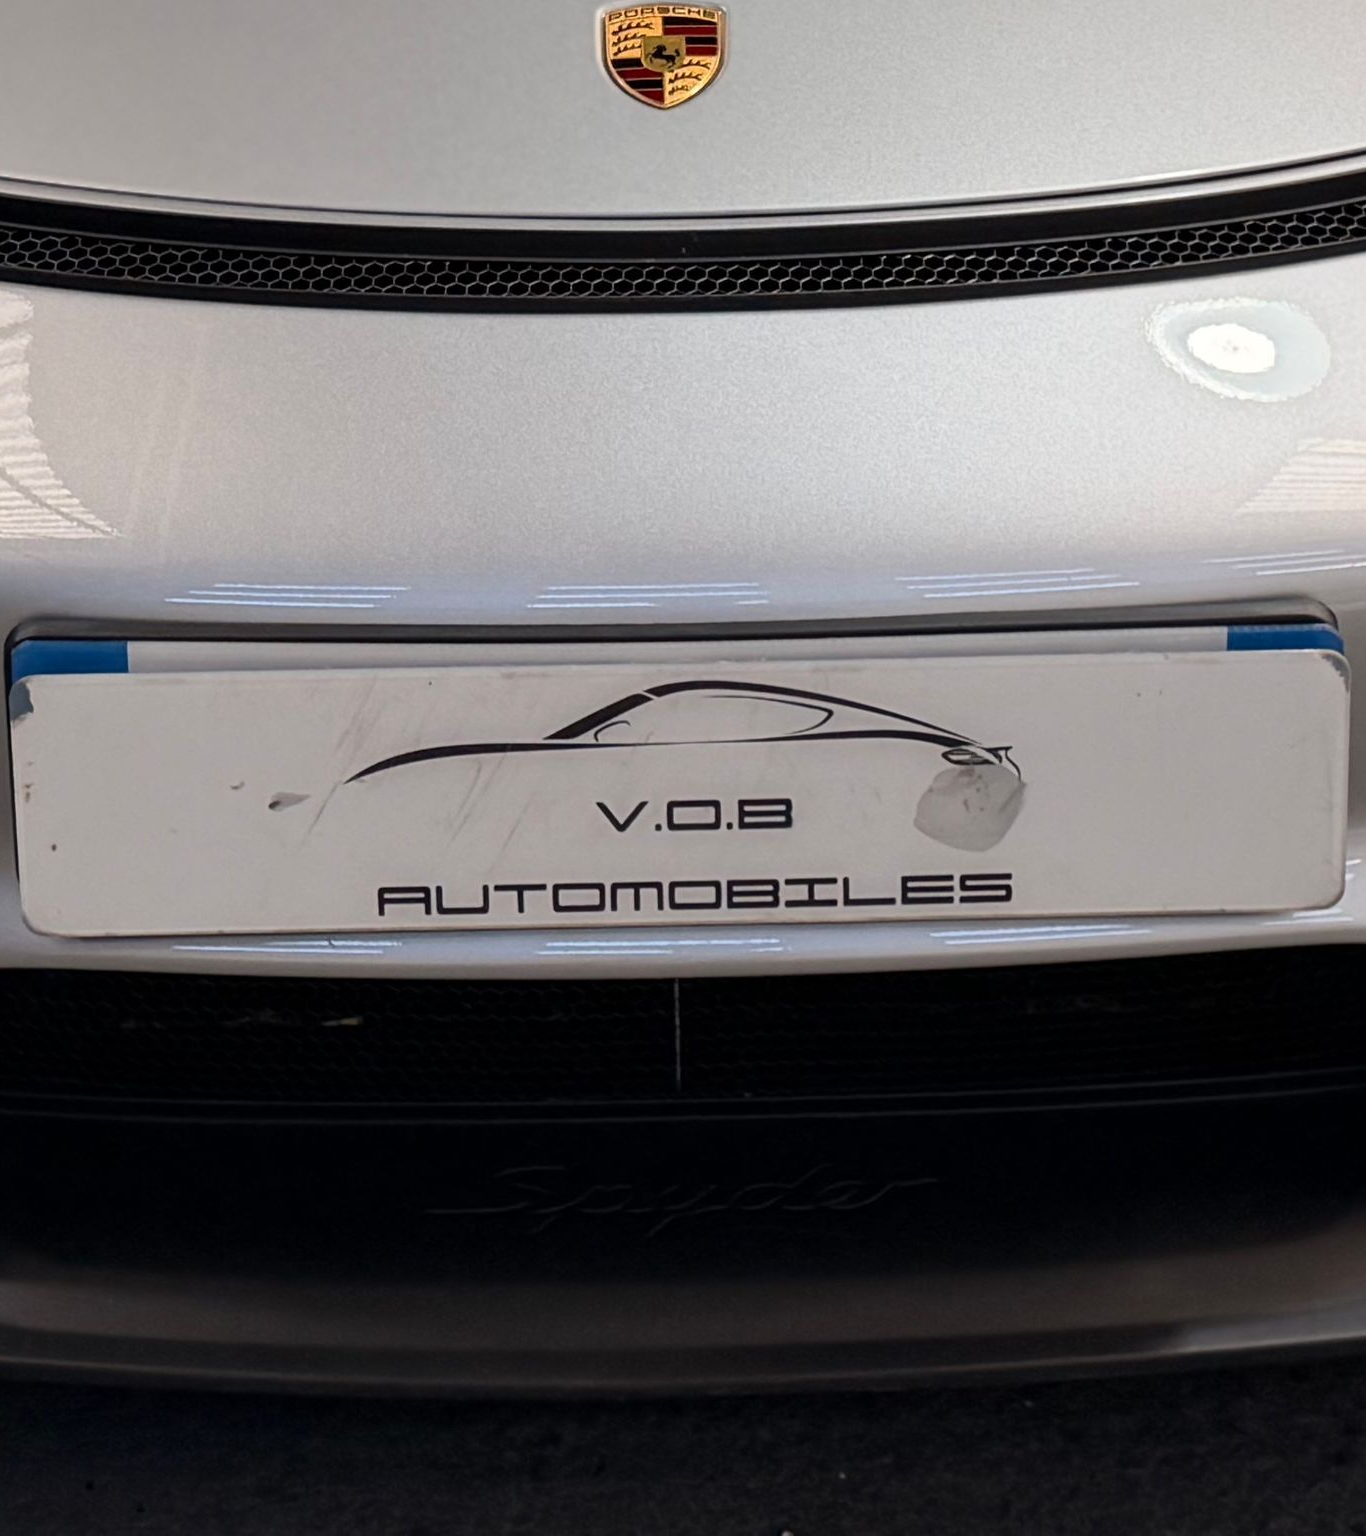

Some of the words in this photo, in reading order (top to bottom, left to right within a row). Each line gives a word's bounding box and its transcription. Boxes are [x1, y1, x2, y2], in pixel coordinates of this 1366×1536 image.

[609, 6, 716, 21] PORSCHE
[595, 798, 793, 833] V.O.B
[377, 872, 1013, 917] AUTOMOBILES
[423, 1163, 939, 1238] Spyder
